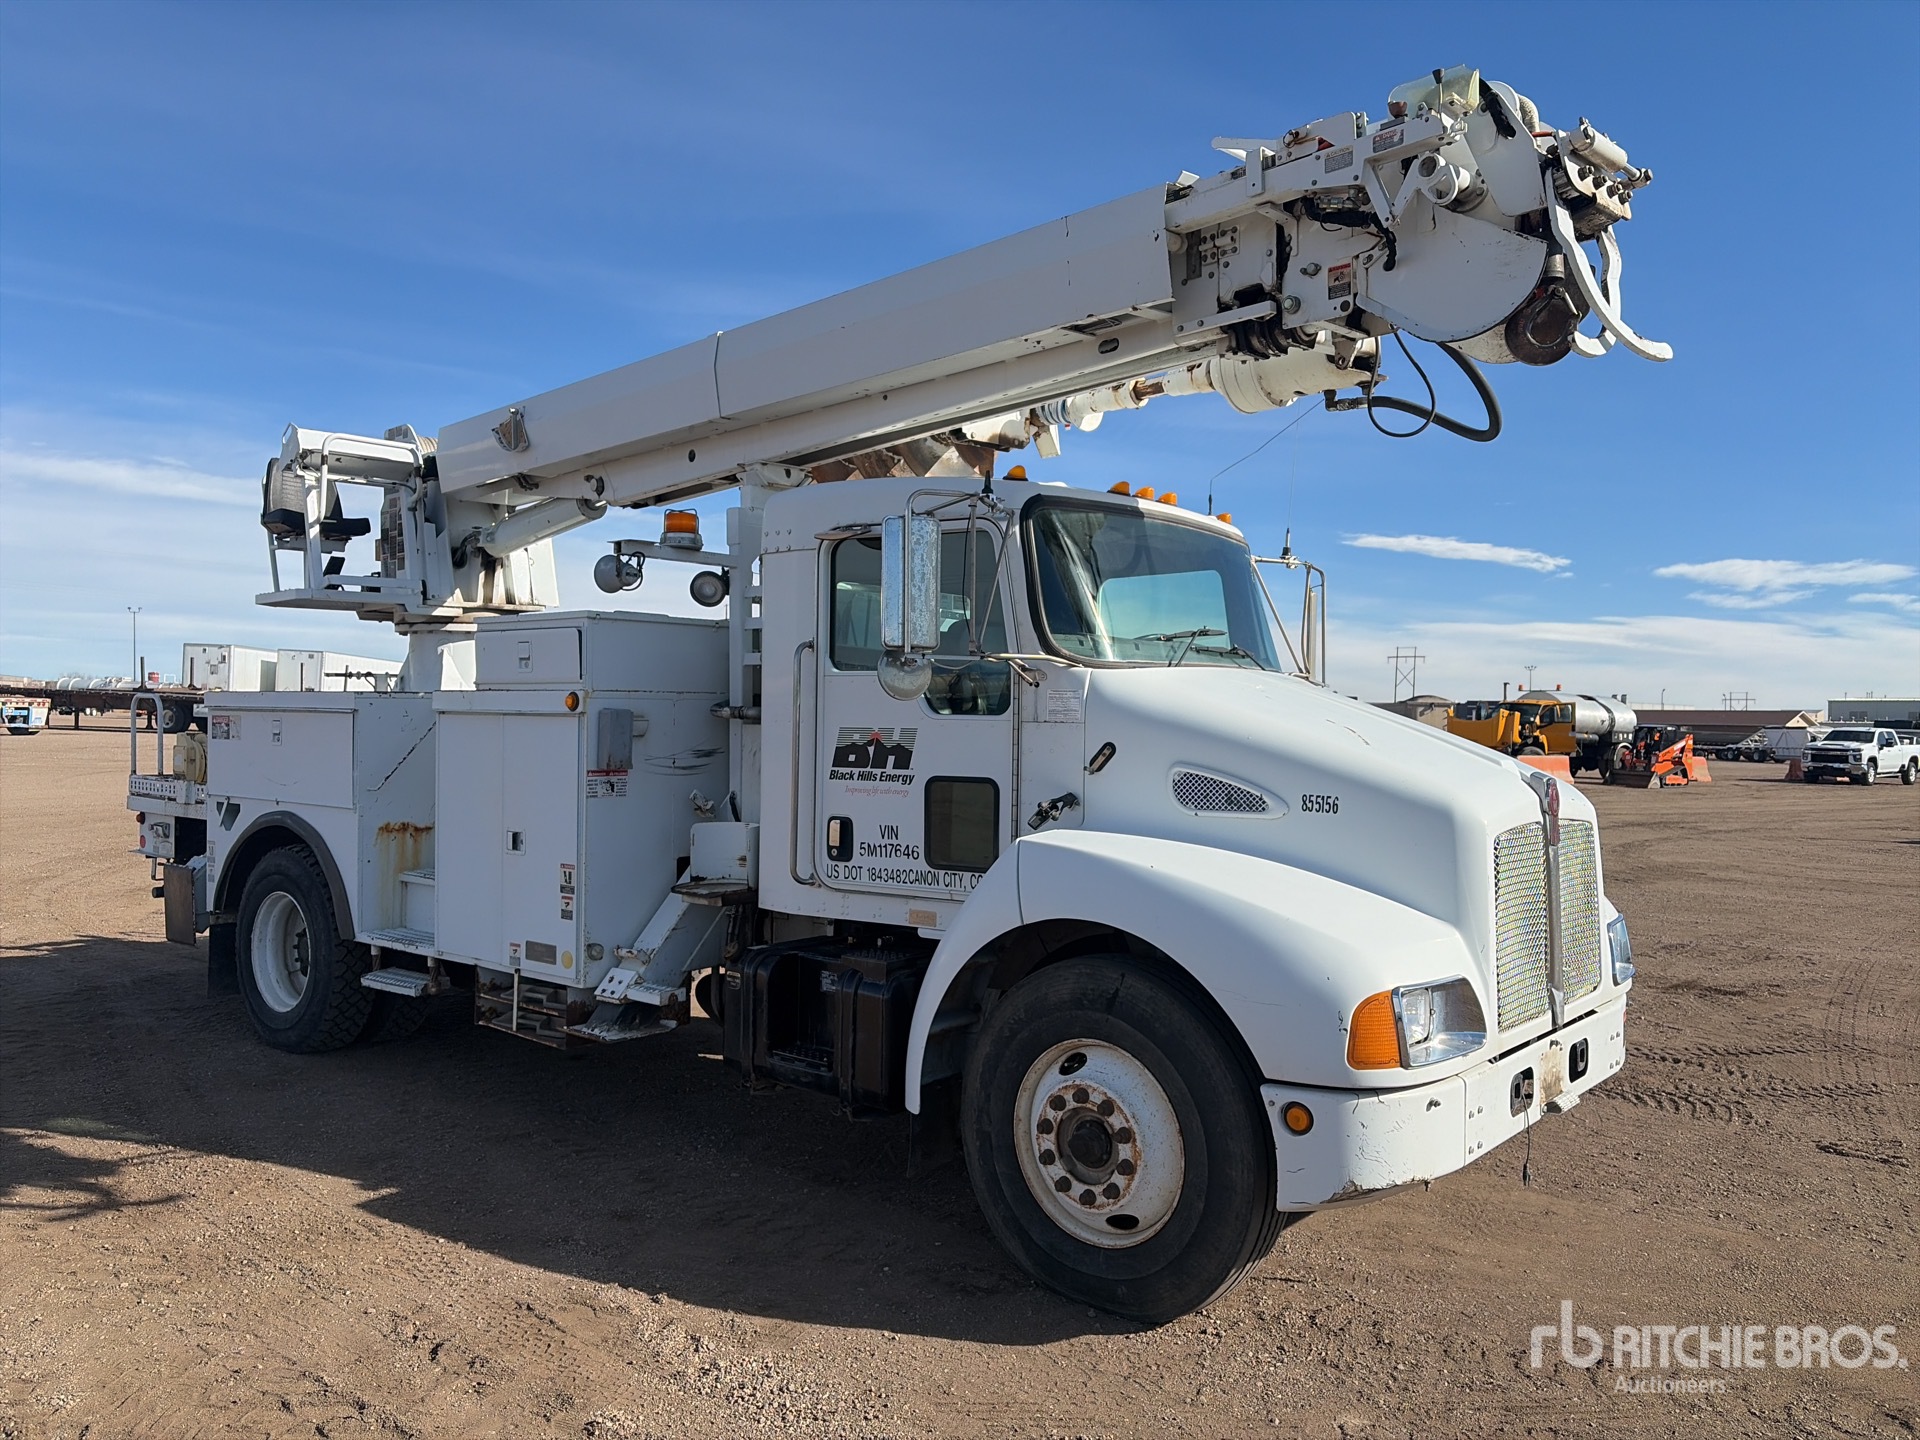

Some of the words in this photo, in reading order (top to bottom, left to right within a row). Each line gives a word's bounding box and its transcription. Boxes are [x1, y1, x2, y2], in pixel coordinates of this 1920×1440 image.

[829, 770, 855, 781] Black
[857, 771, 878, 782] Hills
[878, 771, 915, 786] Energy
[1301, 794, 1339, 814] 855156
[879, 825, 899, 840] VIN
[859, 842, 920, 860] 5M117646
[826, 864, 840, 879] US
[843, 865, 863, 881] DOT
[943, 872, 967, 892] CITY,
